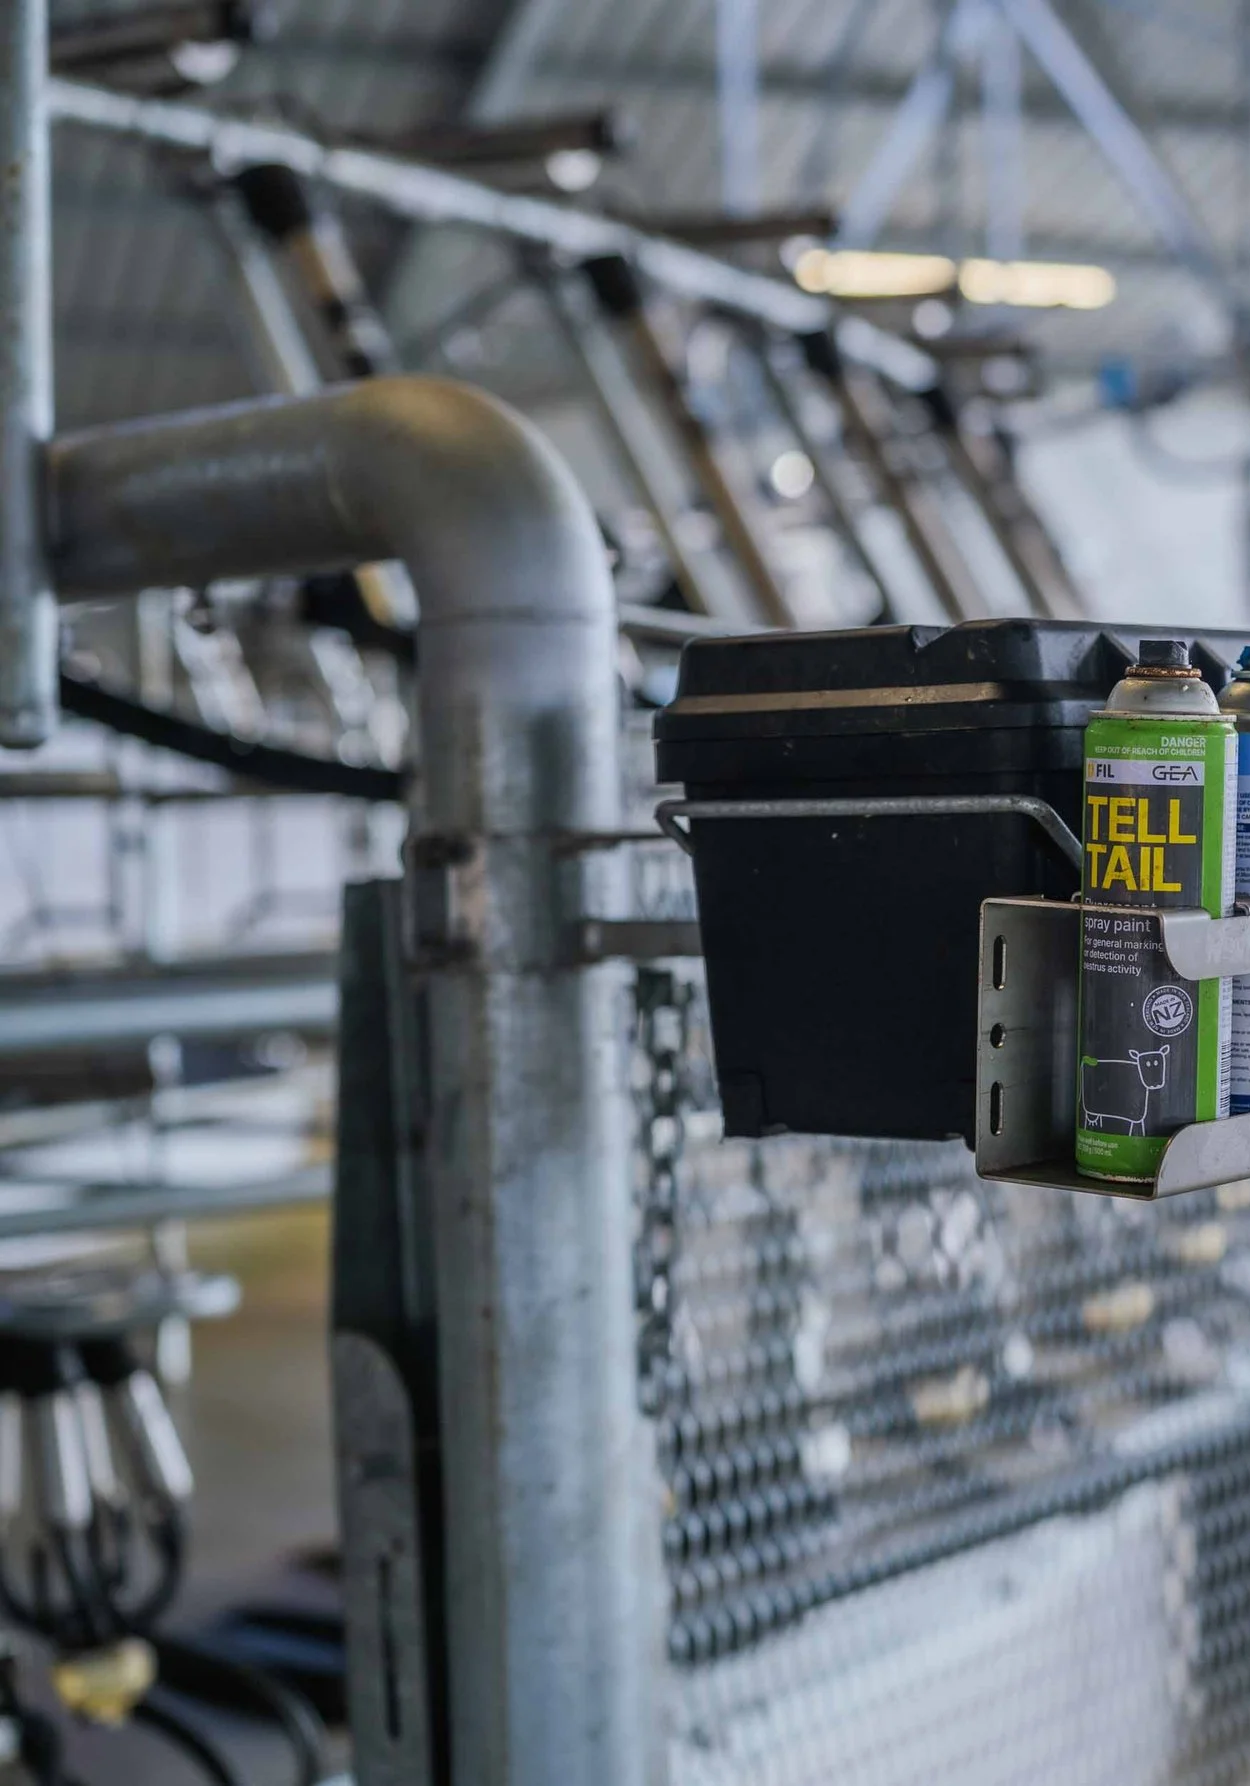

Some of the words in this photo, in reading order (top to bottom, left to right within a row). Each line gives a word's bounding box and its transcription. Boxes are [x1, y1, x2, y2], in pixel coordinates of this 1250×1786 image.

[1161, 736, 1206, 748] DANGER
[1095, 746, 1107, 754] KEEP
[1107, 746, 1120, 754] OUT
[1121, 746, 1130, 754] OF
[1132, 747, 1157, 756] REACH
[1159, 748, 1169, 756] OF
[1170, 748, 1206, 757] CHILDREN
[1096, 763, 1115, 778] FIL
[1152, 765, 1199, 781] GEA
[1087, 795, 1197, 844] TELL
[1086, 843, 1182, 892] TAIL
[1085, 917, 1110, 933] spray
[1114, 918, 1151, 934] paint
[1093, 937, 1122, 949] general
[1124, 940, 1164, 952] marking
[1089, 949, 1126, 961] detection
[1128, 951, 1139, 962] of
[1107, 964, 1142, 977] activity
[1152, 1001, 1185, 1024] NZ
